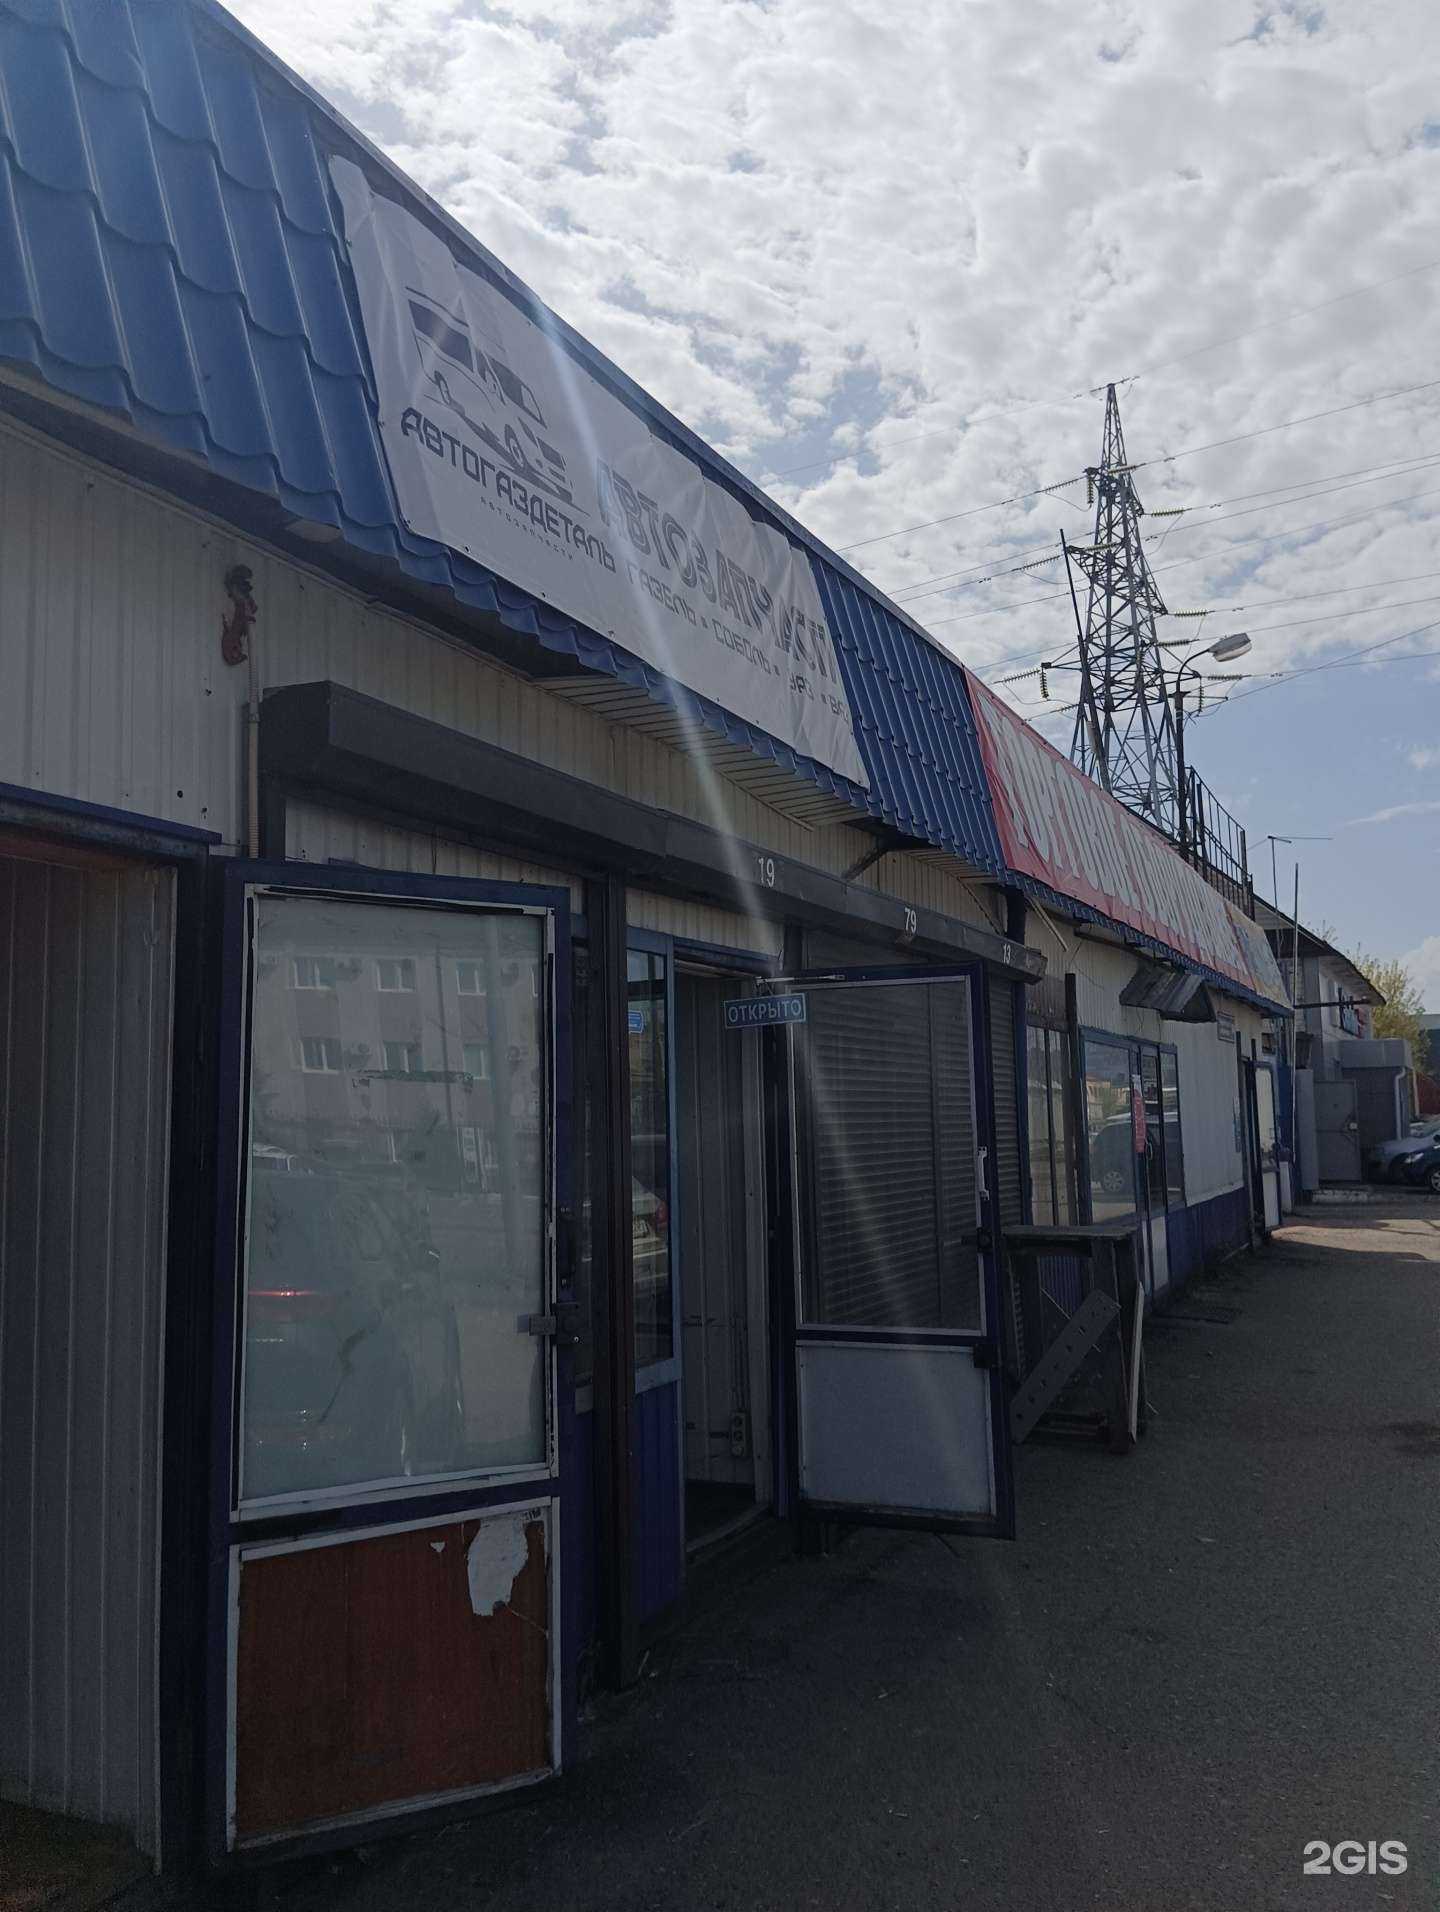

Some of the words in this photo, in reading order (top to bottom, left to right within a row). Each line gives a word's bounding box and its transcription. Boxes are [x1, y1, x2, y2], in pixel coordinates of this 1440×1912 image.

[401, 406, 616, 573] АВТОГАЗДЕТАЛЬ
[627, 563, 697, 626] ГАЗЕЛЬ
[758, 857, 775, 887] 19
[728, 999, 801, 1023] ОТКРЫТО
